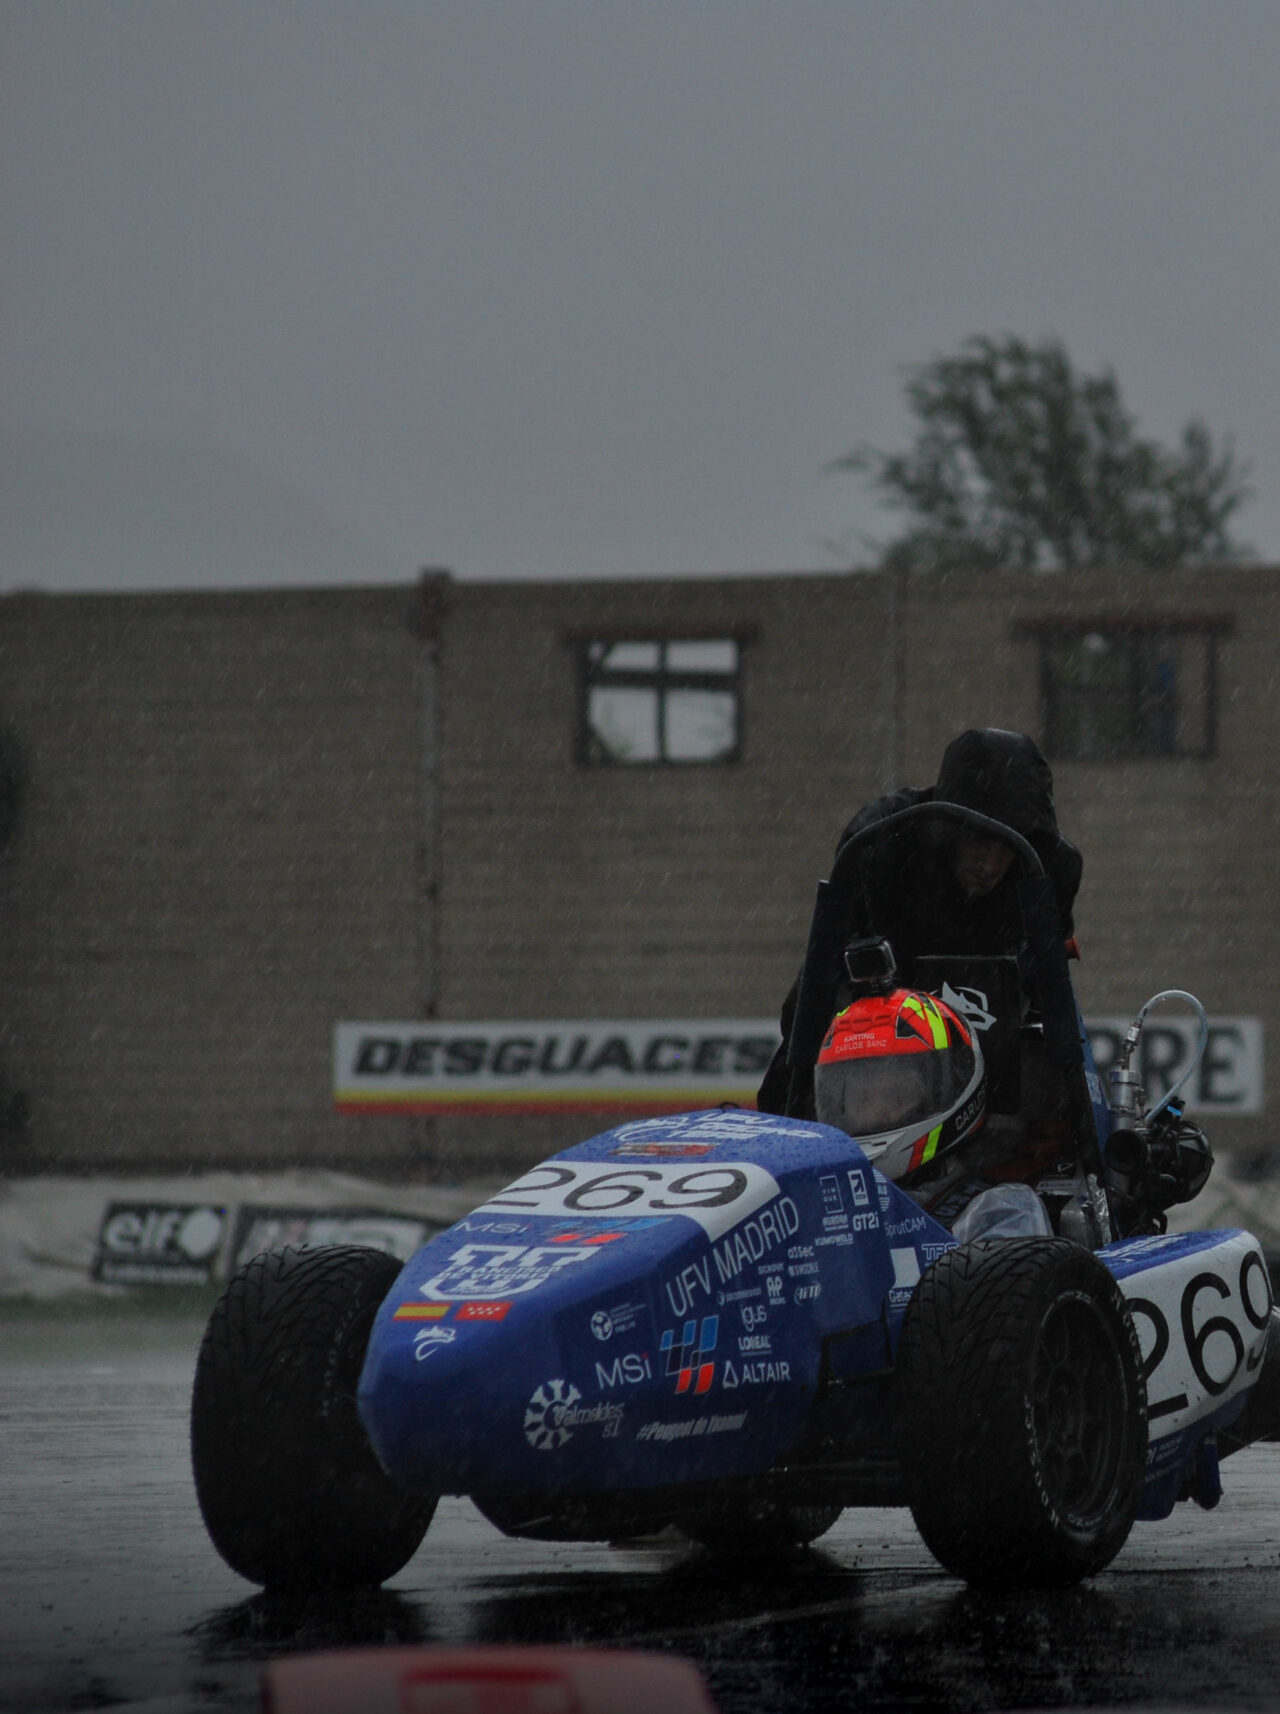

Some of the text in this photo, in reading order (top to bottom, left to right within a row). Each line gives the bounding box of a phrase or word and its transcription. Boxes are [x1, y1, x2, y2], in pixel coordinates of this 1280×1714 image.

[354, 1036, 784, 1075] DESGUACES
[844, 1032, 875, 1042] KARTING
[955, 1083, 986, 1131] CARLO
[484, 1166, 747, 1211] 269
[852, 1211, 880, 1231] GT2i
[664, 1255, 712, 1318] UFV
[712, 1196, 799, 1284] MADRID
[1124, 1250, 1273, 1421] 269
[595, 1351, 652, 1390] MSi
[741, 1360, 792, 1385] ALTAIR
